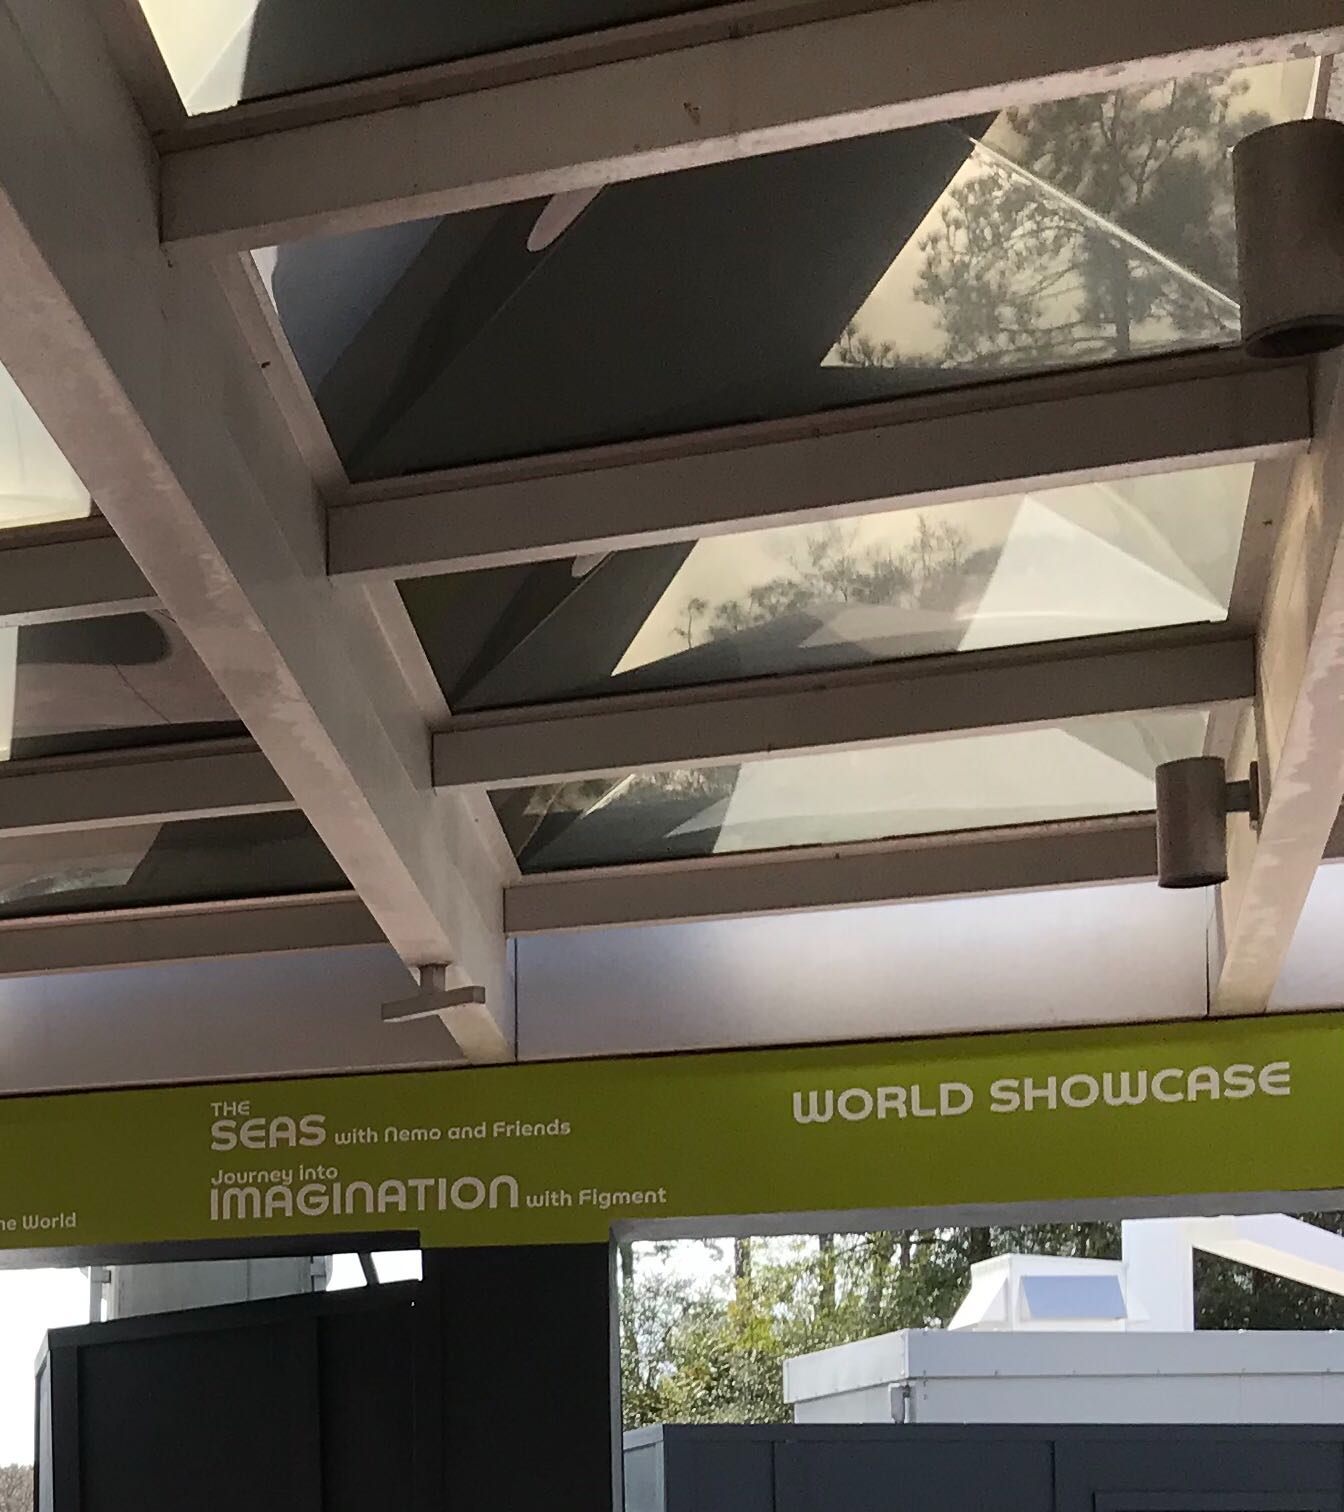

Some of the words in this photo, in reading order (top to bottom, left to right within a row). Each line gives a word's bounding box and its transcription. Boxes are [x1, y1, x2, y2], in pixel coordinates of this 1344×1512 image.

[792, 1082, 973, 1124] WORLD
[990, 1061, 1291, 1113] SHOWCASE
[211, 1101, 250, 1117] THE
[211, 1114, 326, 1151] SEAS
[334, 1127, 378, 1145] with
[384, 1126, 441, 1143] Nemo
[448, 1122, 486, 1140] and
[493, 1119, 571, 1138] Friends
[211, 1168, 293, 1185] Journey
[299, 1164, 338, 1181] into
[210, 1175, 519, 1220] IMAGINATION
[526, 1189, 572, 1208] with
[579, 1187, 667, 1210] Figment
[22, 1213, 77, 1230] World
